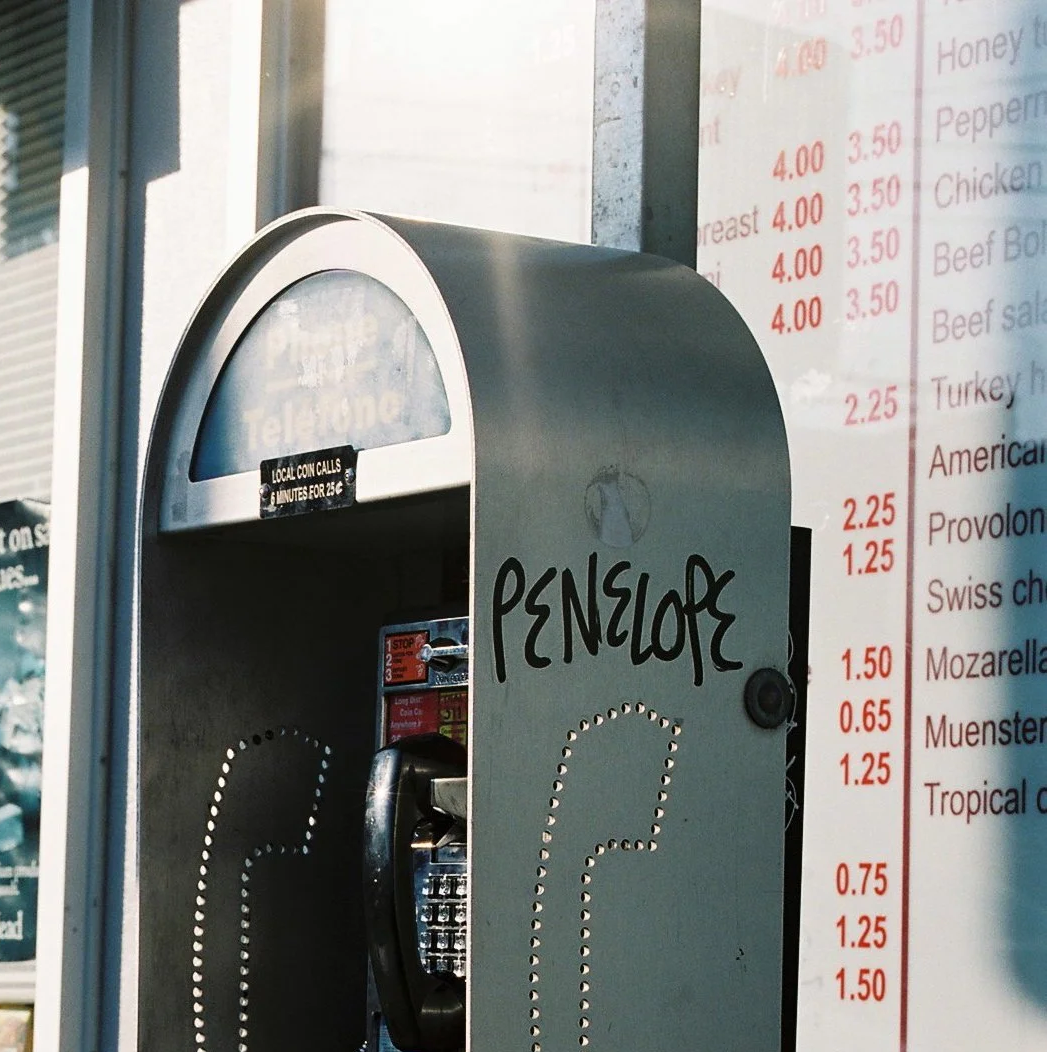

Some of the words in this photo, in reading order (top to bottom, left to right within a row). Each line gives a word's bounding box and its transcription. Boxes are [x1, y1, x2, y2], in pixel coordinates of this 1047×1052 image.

[851, 15, 905, 59] 3.50
[938, 26, 1023, 75] Honey
[772, 140, 825, 182] 4.00
[848, 121, 902, 164] 3.50
[772, 193, 824, 232] 4.00
[848, 174, 901, 217] 3.50
[935, 160, 1042, 209] Chicken
[772, 245, 823, 284] 4.00
[847, 228, 900, 270] 3.50
[933, 230, 996, 276] Beef
[771, 296, 822, 335] 4.00
[847, 280, 899, 322] 3.50
[932, 299, 994, 344] Beef
[844, 385, 898, 427] 2.25
[931, 371, 1021, 411] Turkey
[272, 468, 296, 484] LOCAL
[297, 462, 315, 479] COIN
[316, 458, 341, 476] CALLS
[271, 491, 276, 505] 6
[276, 486, 307, 505] MINUTES
[309, 484, 325, 500] FOR
[843, 493, 896, 531] 2.25
[9, 526, 34, 553] on
[843, 539, 895, 576] 1.25
[927, 575, 1003, 614] Swiss
[1012, 569, 1047, 607] ch
[492, 551, 743, 687] PENELOPE
[392, 637, 414, 650] STOP
[841, 645, 892, 681] 1.50
[839, 699, 892, 734] 0.65
[925, 712, 1047, 749] Muenster
[839, 752, 891, 786] 1.25
[924, 779, 1027, 825] Tropical
[836, 862, 888, 896] 0.75
[836, 915, 887, 949] 1.25
[835, 968, 886, 1002] 1.50
